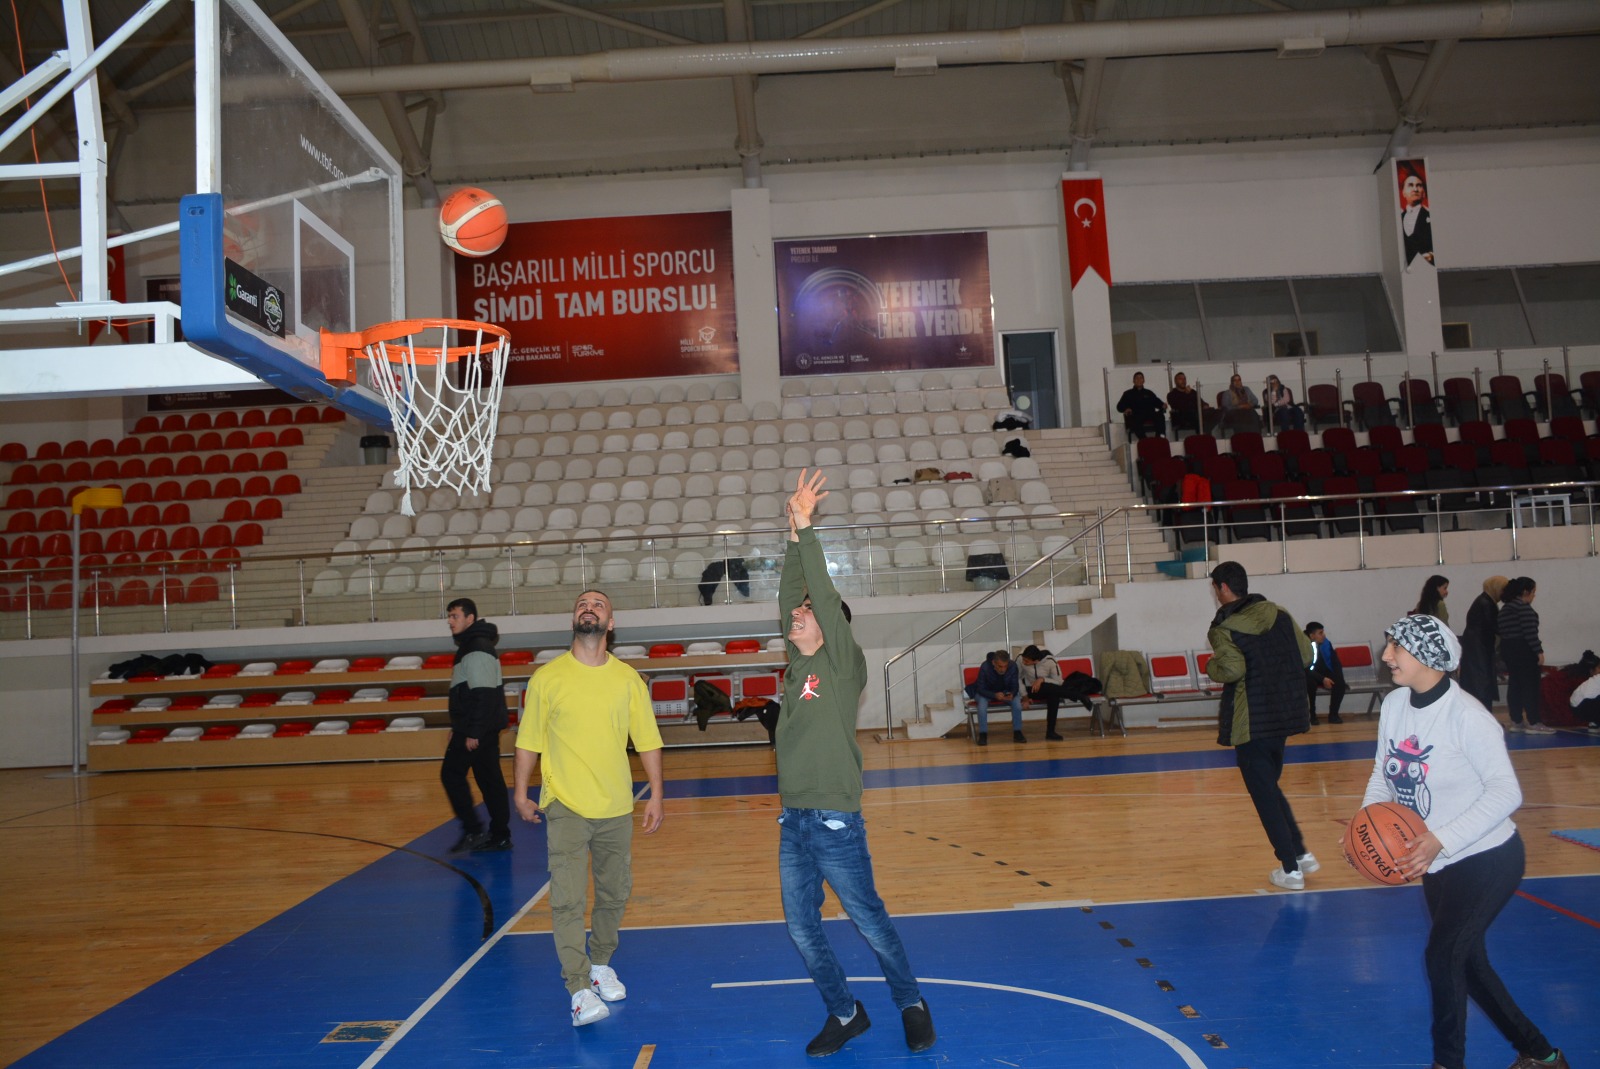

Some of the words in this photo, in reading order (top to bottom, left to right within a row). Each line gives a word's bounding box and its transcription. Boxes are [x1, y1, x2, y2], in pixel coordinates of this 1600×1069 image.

[473, 258, 566, 291] BAŞARILI
[572, 249, 627, 281] MİLLİ
[633, 248, 715, 278] SPORCU
[236, 284, 258, 308] Garanti
[554, 291, 605, 319] TAM
[612, 284, 717, 315] BURSLU!
[876, 278, 962, 309] YETENEK
[878, 311, 918, 339] HER
[921, 307, 984, 336] YERDE
[552, 345, 561, 353] VE
[1356, 823, 1396, 877] SPALDING
